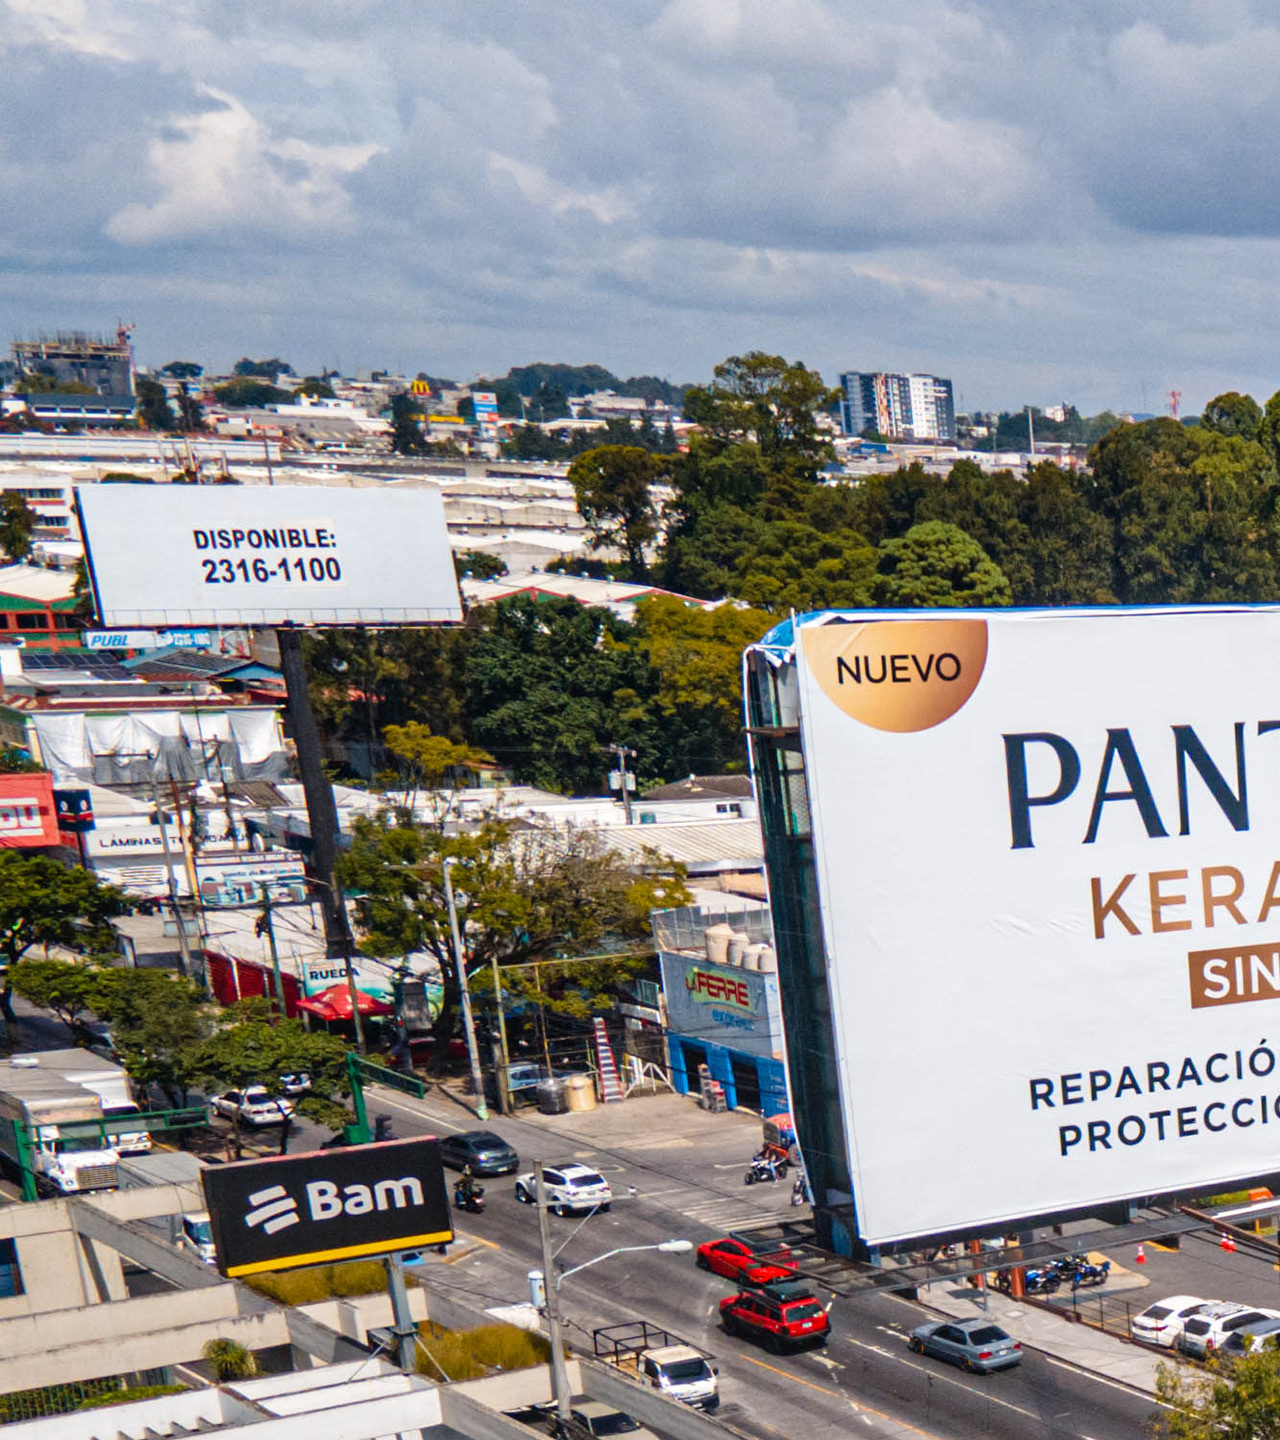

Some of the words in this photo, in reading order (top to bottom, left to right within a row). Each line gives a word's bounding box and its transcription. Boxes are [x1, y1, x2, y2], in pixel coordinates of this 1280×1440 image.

[193, 529, 337, 549] DISPONIBLE:
[202, 557, 342, 584] 2316-1100
[836, 653, 962, 685] NUEVO
[100, 834, 163, 849] LÁMINAS
[309, 968, 359, 981] RUEDA
[1203, 952, 1280, 999] SIN
[696, 971, 750, 1008] FERRE
[306, 1177, 425, 1221] Bam
